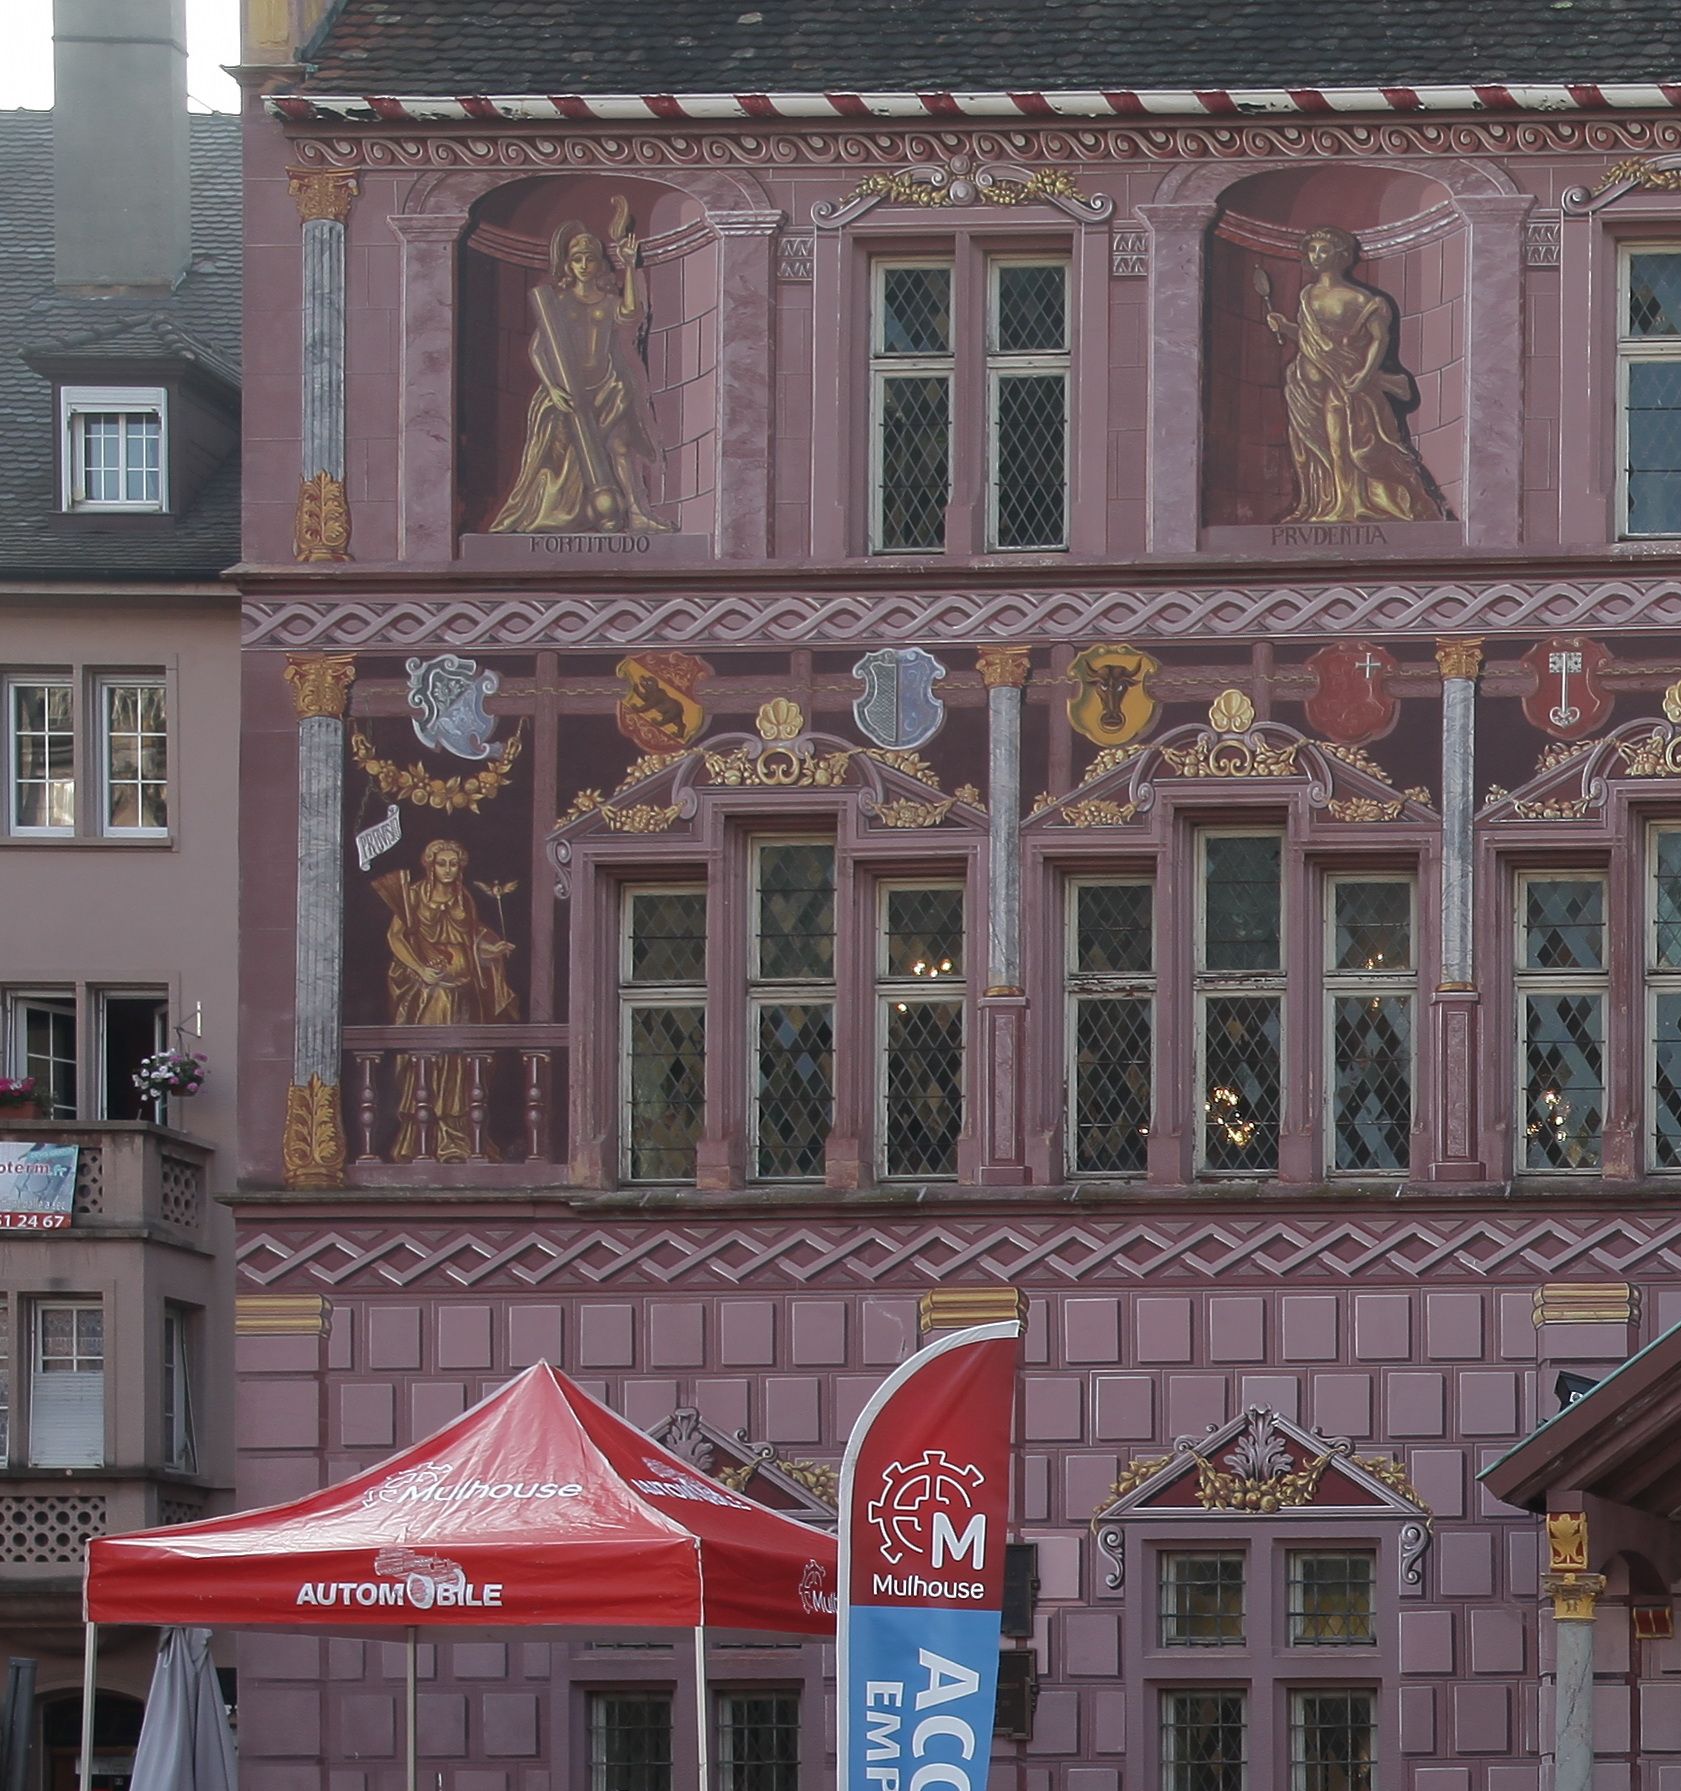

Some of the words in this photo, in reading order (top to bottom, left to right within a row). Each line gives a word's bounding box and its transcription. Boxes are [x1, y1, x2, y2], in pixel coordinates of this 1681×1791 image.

[529, 535, 650, 553] FORTITUDO
[1271, 526, 1388, 546] PRVDENTIA
[17, 1215, 38, 1228] 24
[42, 1215, 64, 1228] 67
[400, 1479, 584, 1502] Mulhouse
[296, 1570, 503, 1609] AUTOMOBILE
[872, 1573, 985, 1600] Mulhouse
